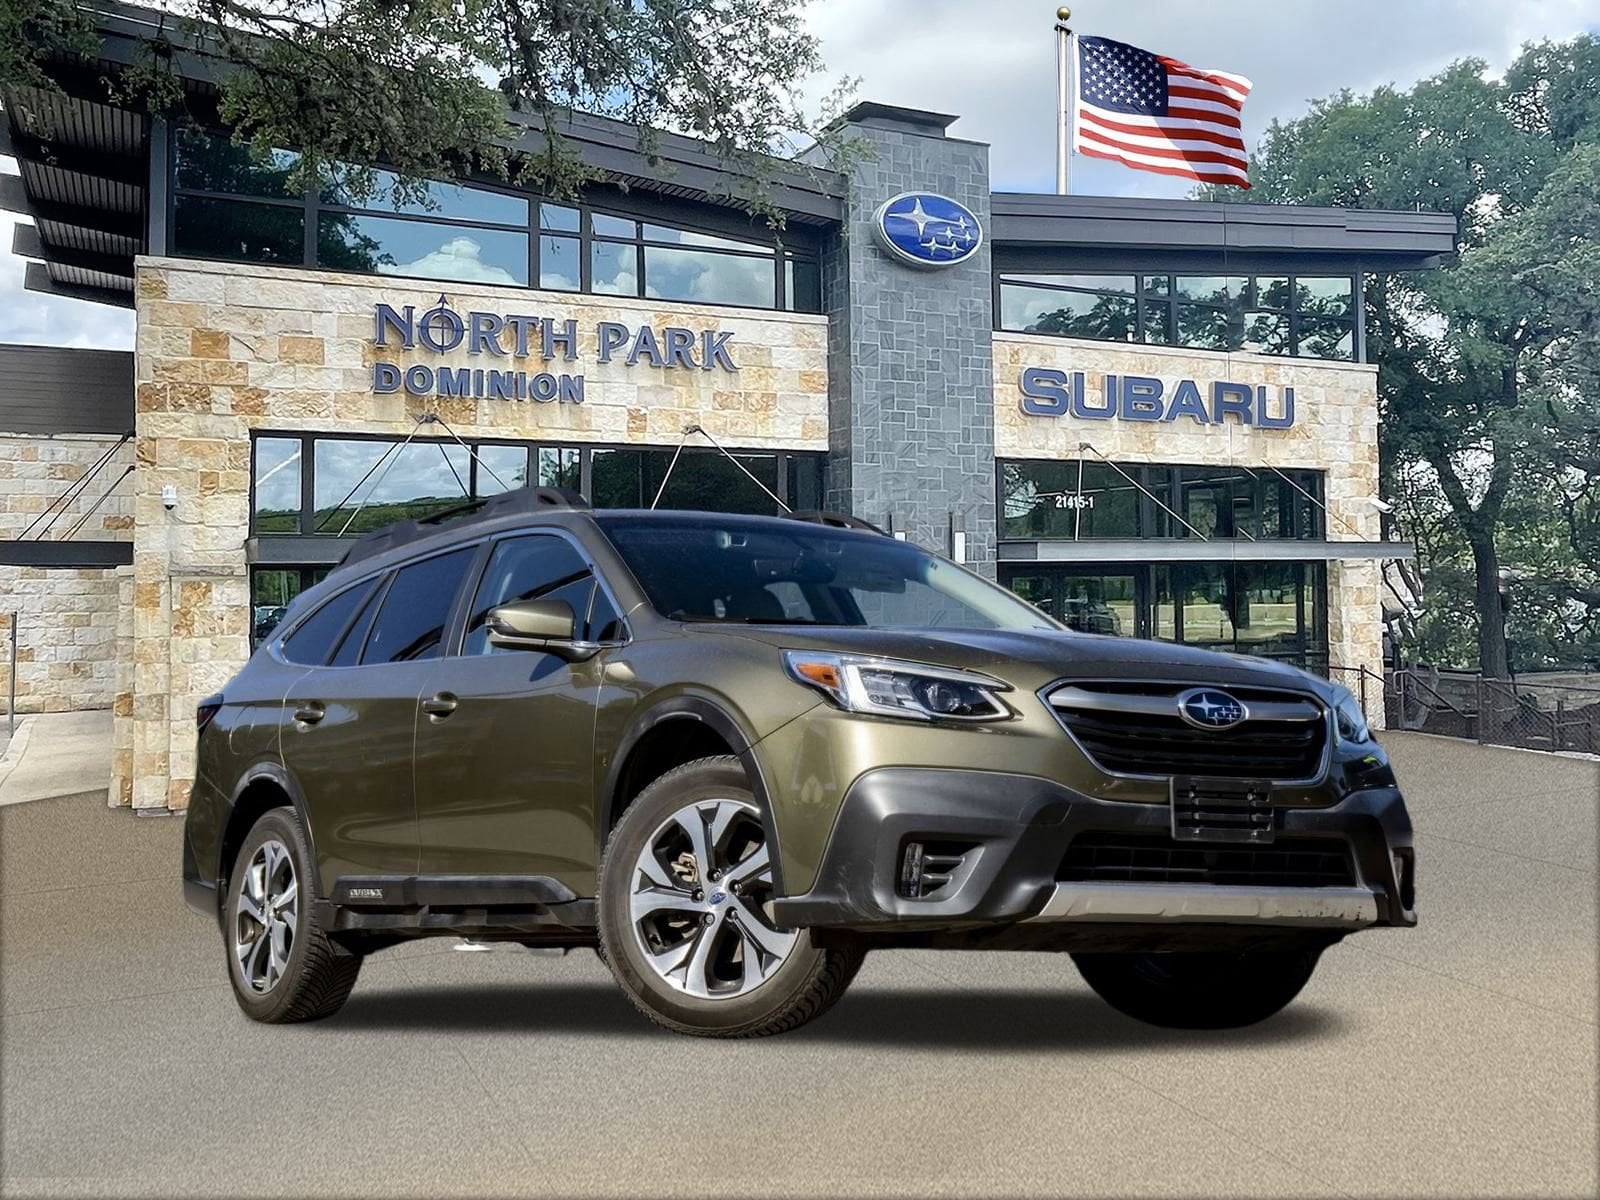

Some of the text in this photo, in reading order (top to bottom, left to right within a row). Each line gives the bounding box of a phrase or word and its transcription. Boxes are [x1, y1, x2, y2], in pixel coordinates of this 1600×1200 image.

[374, 295, 741, 372] NORTH PARK
[373, 362, 584, 402] DOMINION
[1019, 367, 1295, 429] SUBARU
